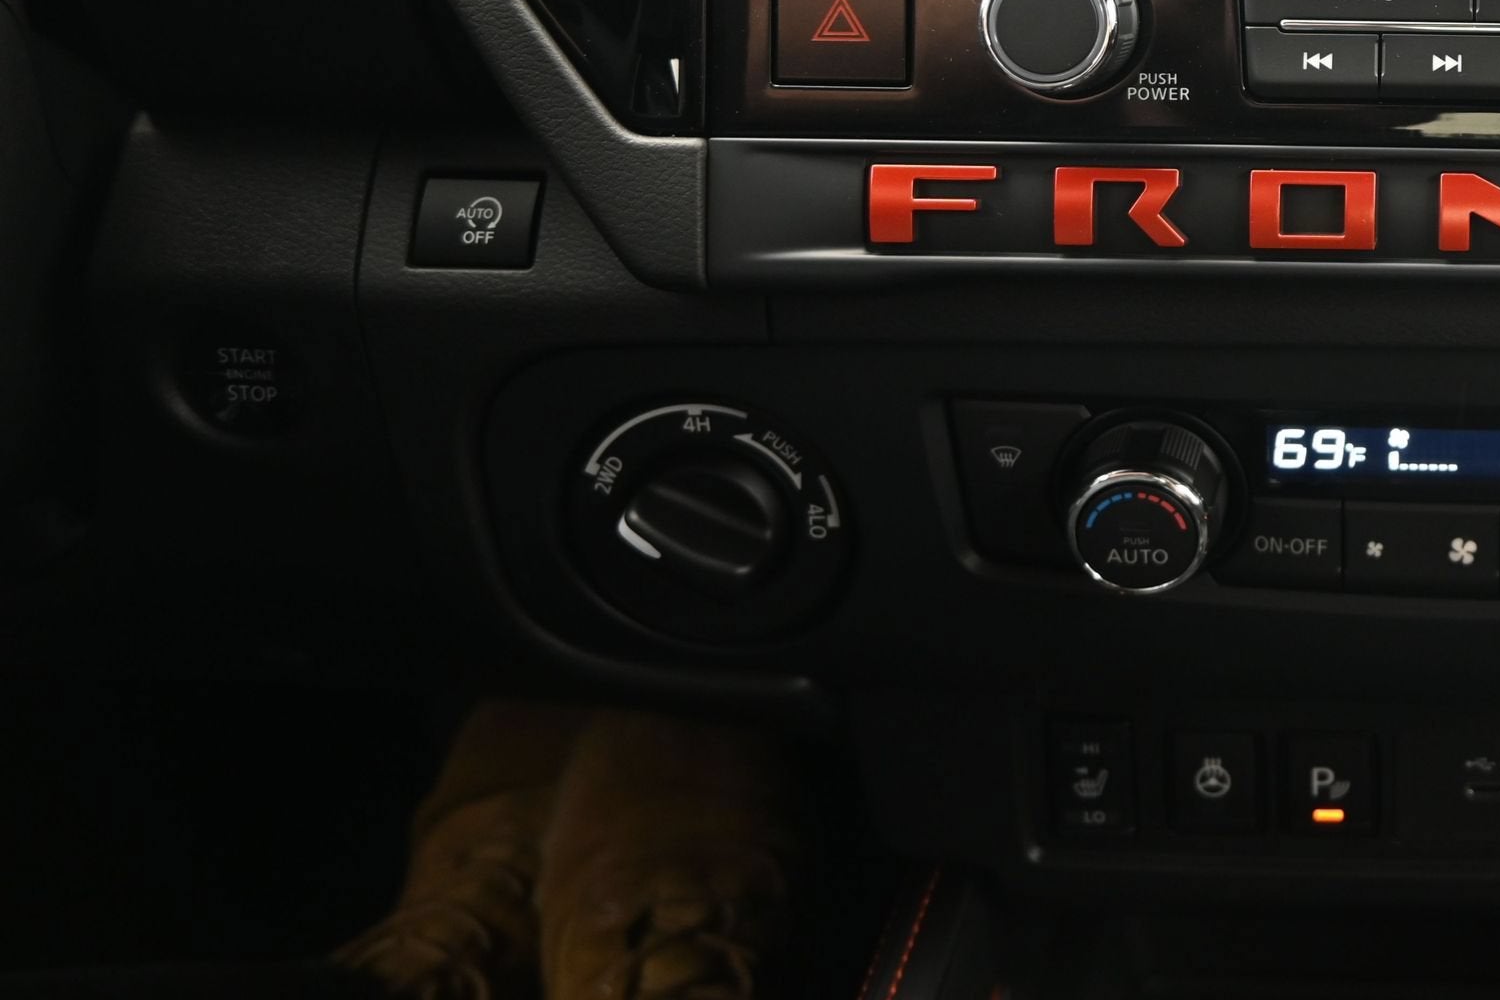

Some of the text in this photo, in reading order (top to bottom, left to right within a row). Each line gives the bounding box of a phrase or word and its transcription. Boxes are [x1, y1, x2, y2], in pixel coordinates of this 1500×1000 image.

[1138, 72, 1178, 86] PUSH
[1127, 86, 1190, 101] POWER
[456, 207, 495, 220] AUTO
[462, 230, 496, 245] OFF
[216, 347, 278, 365] START
[226, 368, 273, 381] ENGINE
[227, 384, 279, 403] STOP
[682, 415, 712, 433] 4H
[761, 429, 804, 466] PUSH
[594, 455, 624, 496] 2WD
[807, 503, 828, 540] 4LO
[1122, 536, 1150, 546] PUSH
[1106, 548, 1169, 566] AUTO
[1082, 810, 1107, 824] LO
